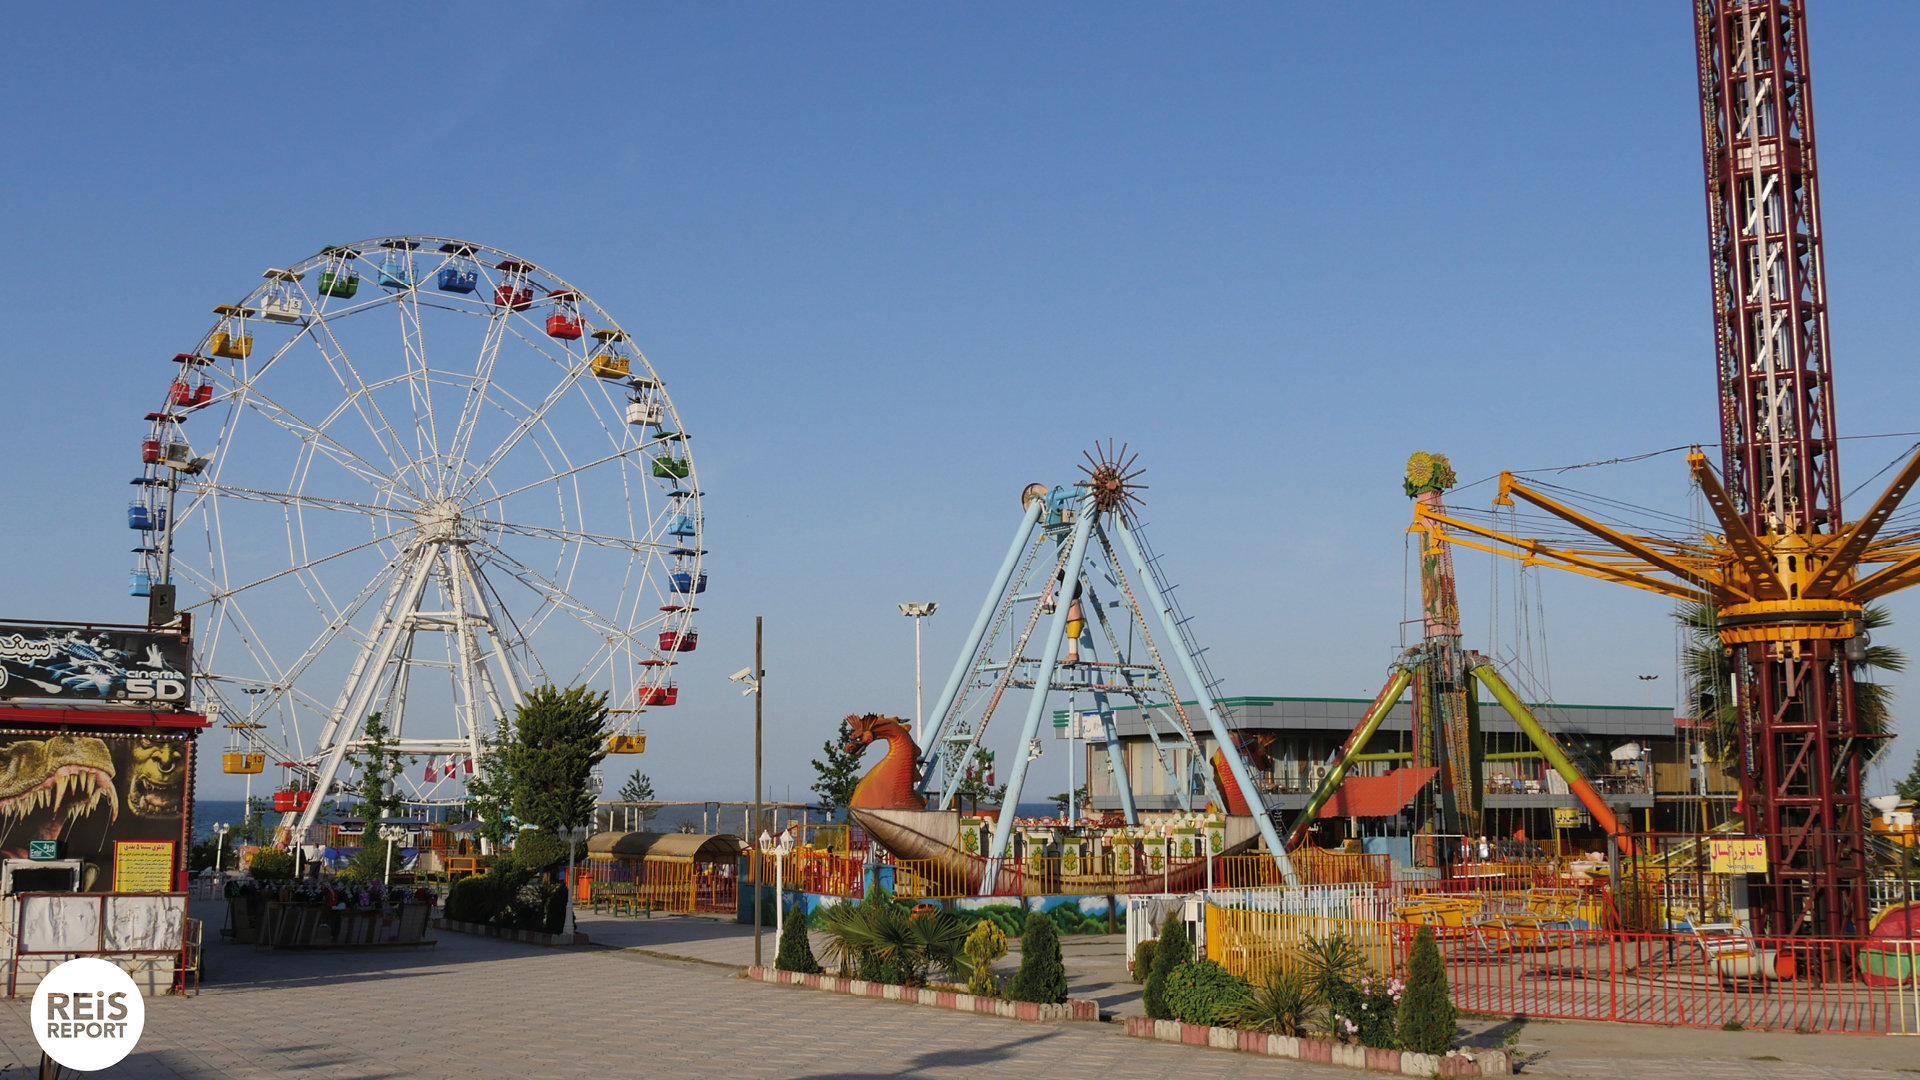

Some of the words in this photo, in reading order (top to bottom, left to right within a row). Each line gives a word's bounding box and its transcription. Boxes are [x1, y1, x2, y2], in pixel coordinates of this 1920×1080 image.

[294, 300, 299, 308] 5
[688, 634, 697, 643] 22
[0, 634, 52, 664] سین
[126, 670, 184, 679] cinema
[126, 679, 186, 700] 5D
[594, 777, 602, 785] 19
[1747, 843, 1763, 859] تاب
